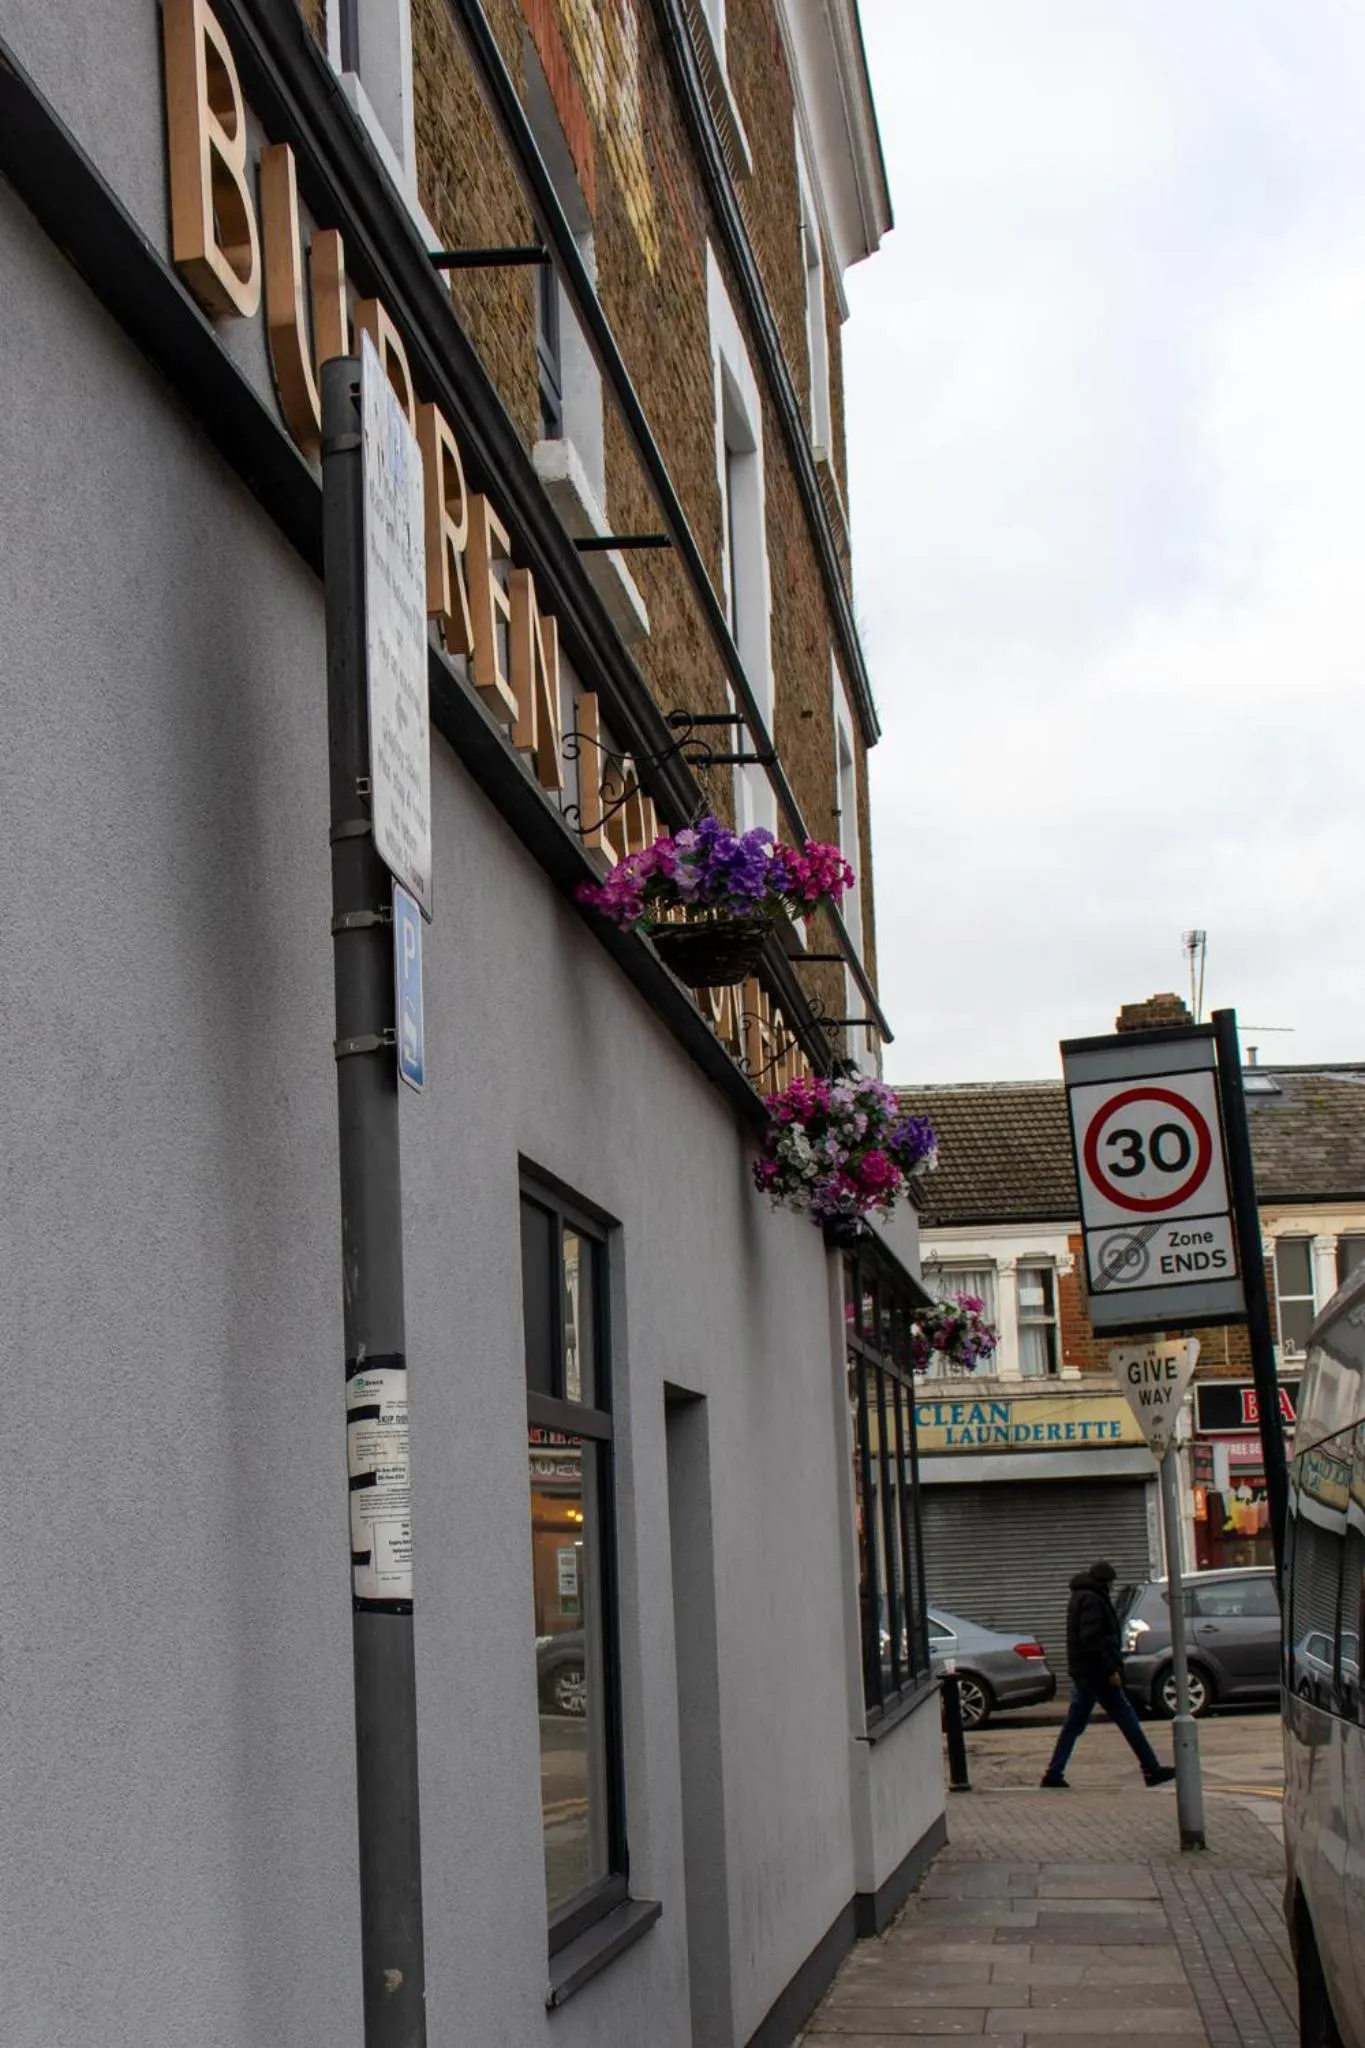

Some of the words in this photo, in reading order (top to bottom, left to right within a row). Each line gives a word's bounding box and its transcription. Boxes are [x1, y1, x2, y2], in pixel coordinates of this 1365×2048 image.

[1105, 1123, 1191, 1177] 30
[1168, 1230, 1214, 1247] Zone
[1160, 1249, 1228, 1274] ENDS
[1127, 1356, 1179, 1385] GIVE
[1138, 1387, 1173, 1406] WAY
[914, 1401, 1011, 1427] CLEAN
[945, 1420, 1122, 1446] LAUNDERETTE
